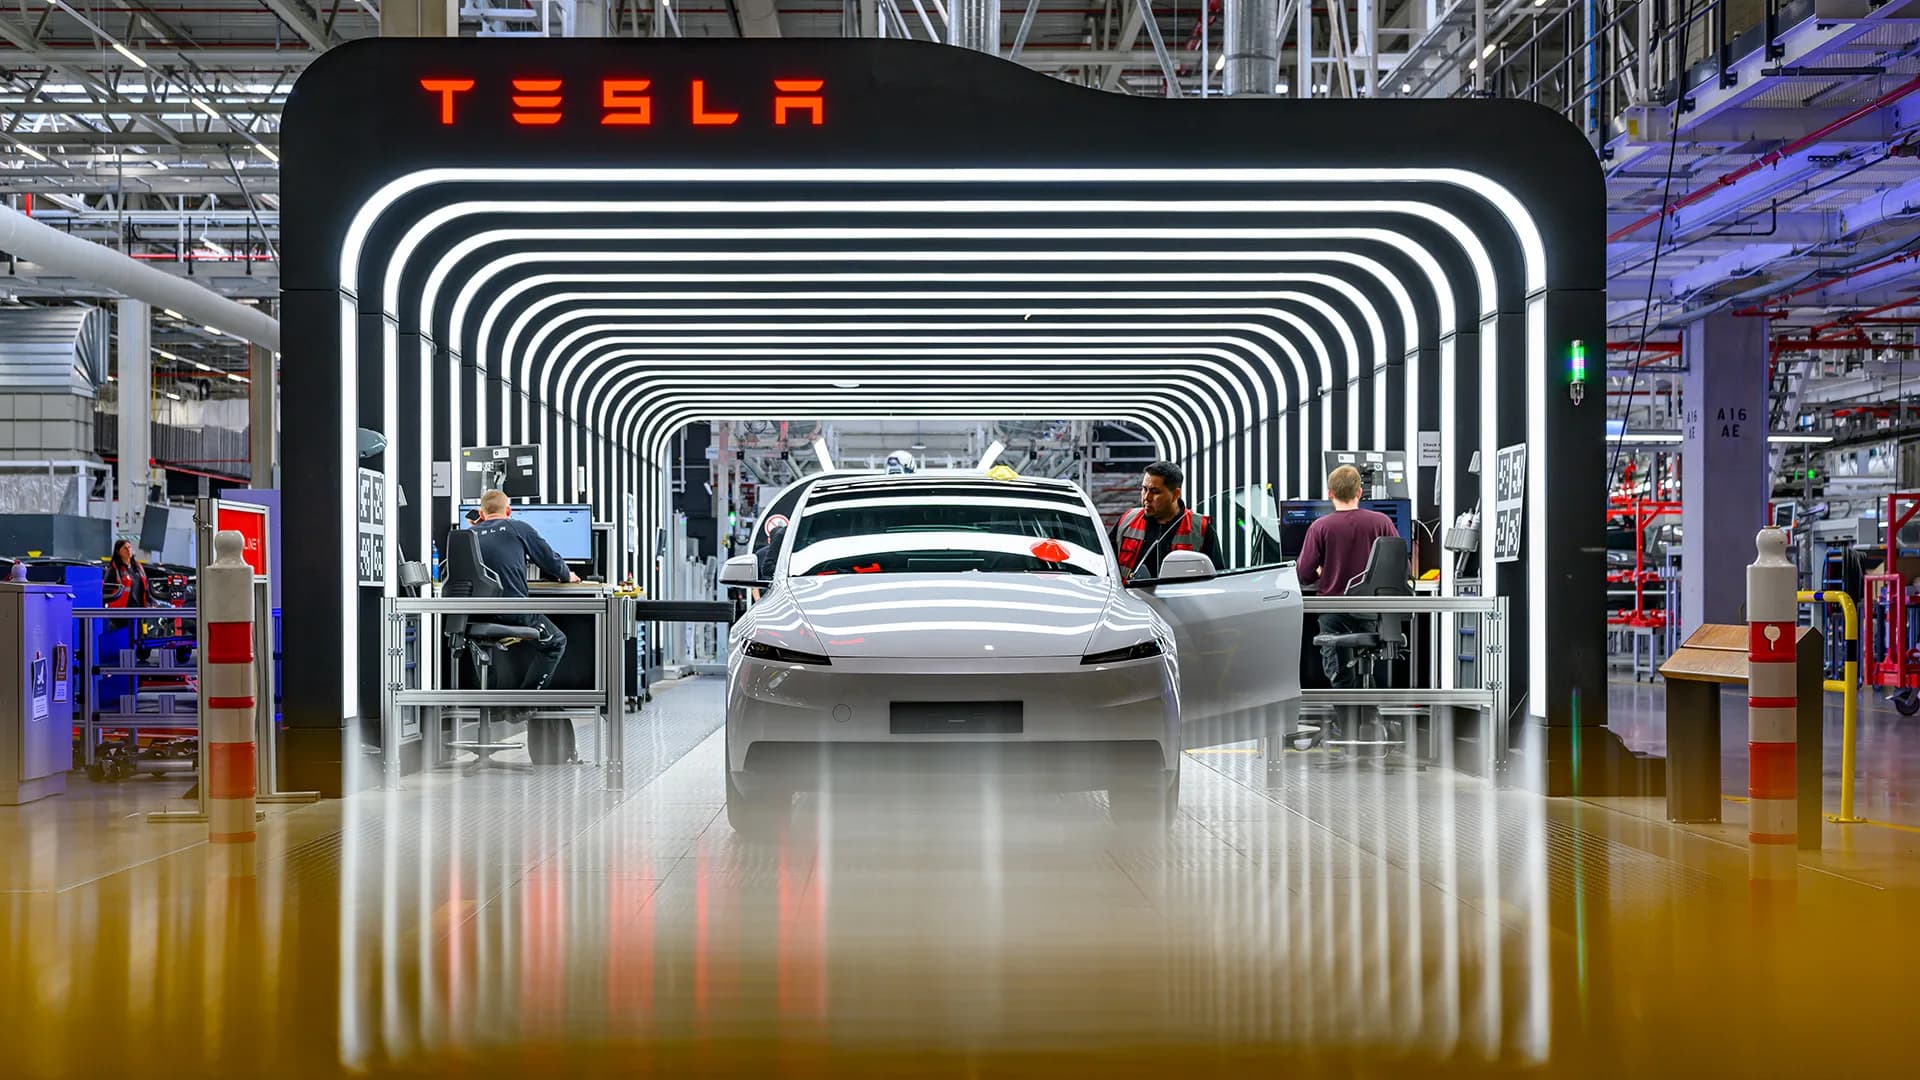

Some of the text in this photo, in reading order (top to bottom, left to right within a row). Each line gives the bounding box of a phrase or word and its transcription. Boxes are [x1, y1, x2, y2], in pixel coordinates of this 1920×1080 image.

[420, 79, 824, 125] TESLA
[1717, 407, 1747, 421] A16
[1720, 424, 1740, 438] AE
